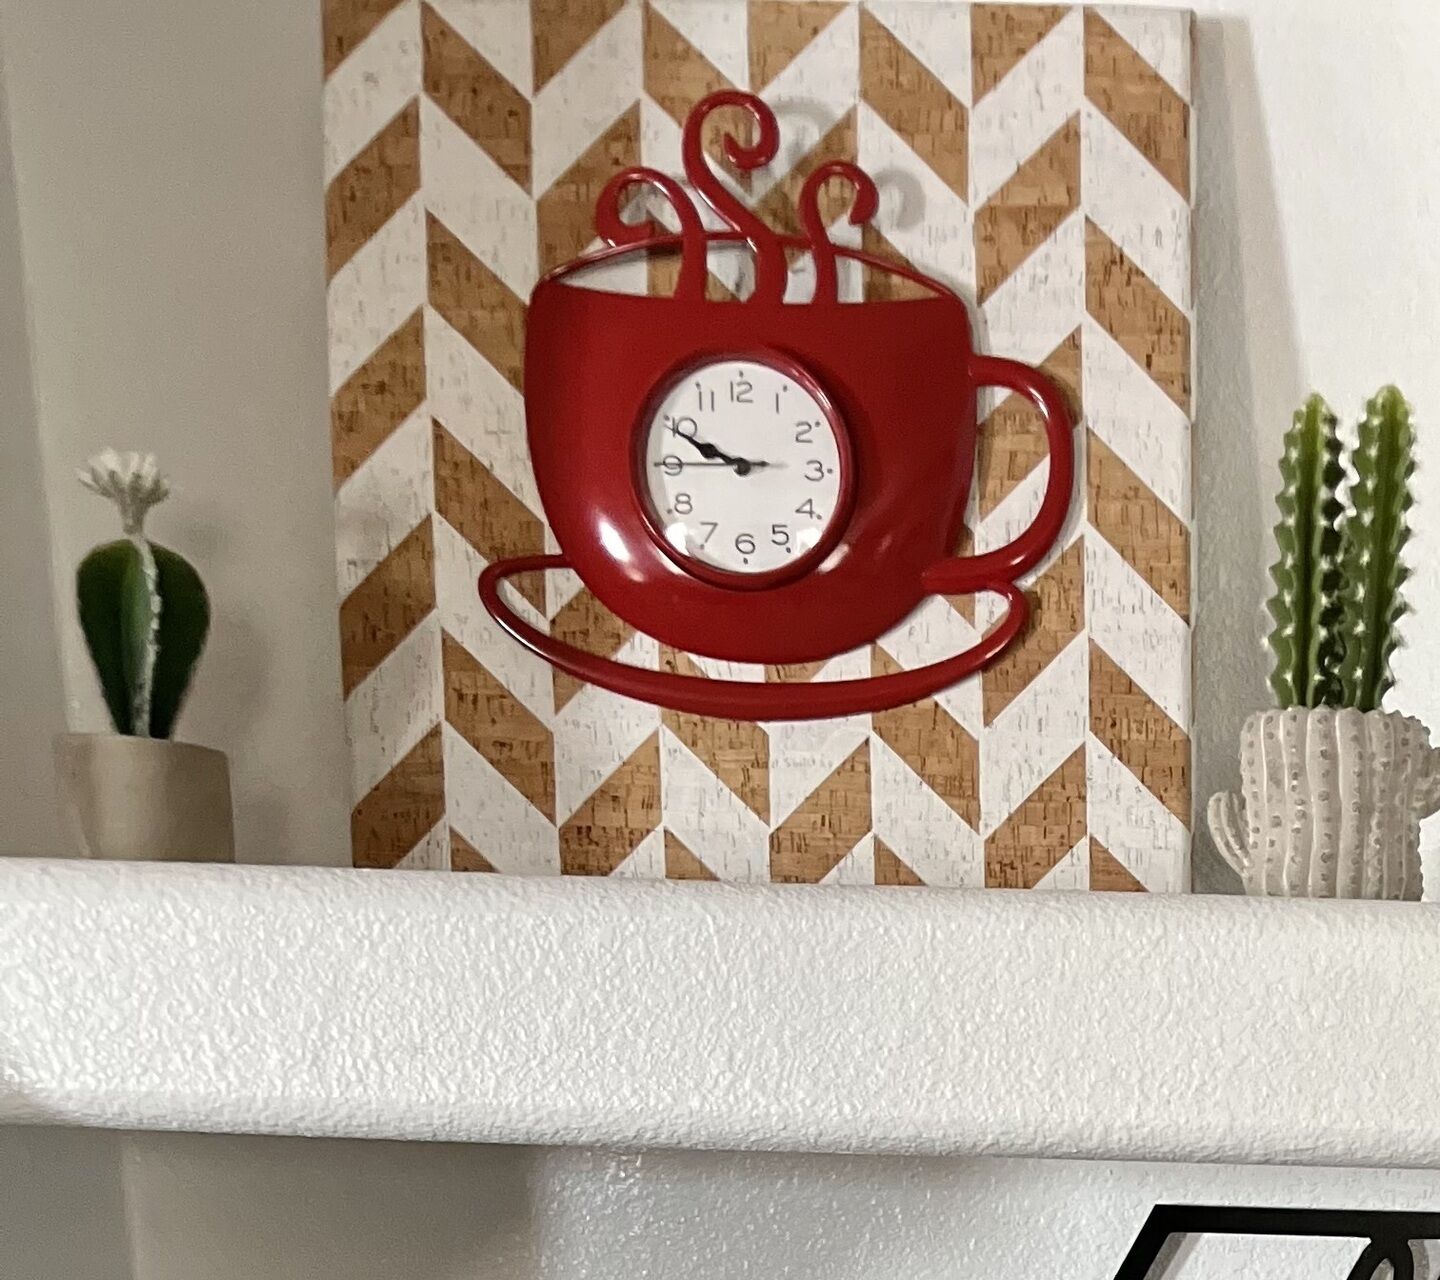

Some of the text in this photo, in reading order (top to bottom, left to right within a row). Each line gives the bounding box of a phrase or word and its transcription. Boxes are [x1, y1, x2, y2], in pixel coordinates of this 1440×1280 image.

[698, 389, 715, 412] 11
[731, 381, 753, 403] 12
[671, 416, 698, 438] 10
[795, 421, 813, 443] 2
[663, 455, 683, 476] 9
[804, 460, 824, 481] 3
[674, 493, 693, 515] 8
[795, 498, 815, 519] 4
[699, 522, 718, 545] 7
[735, 533, 756, 554] 6
[771, 524, 789, 546] 5
